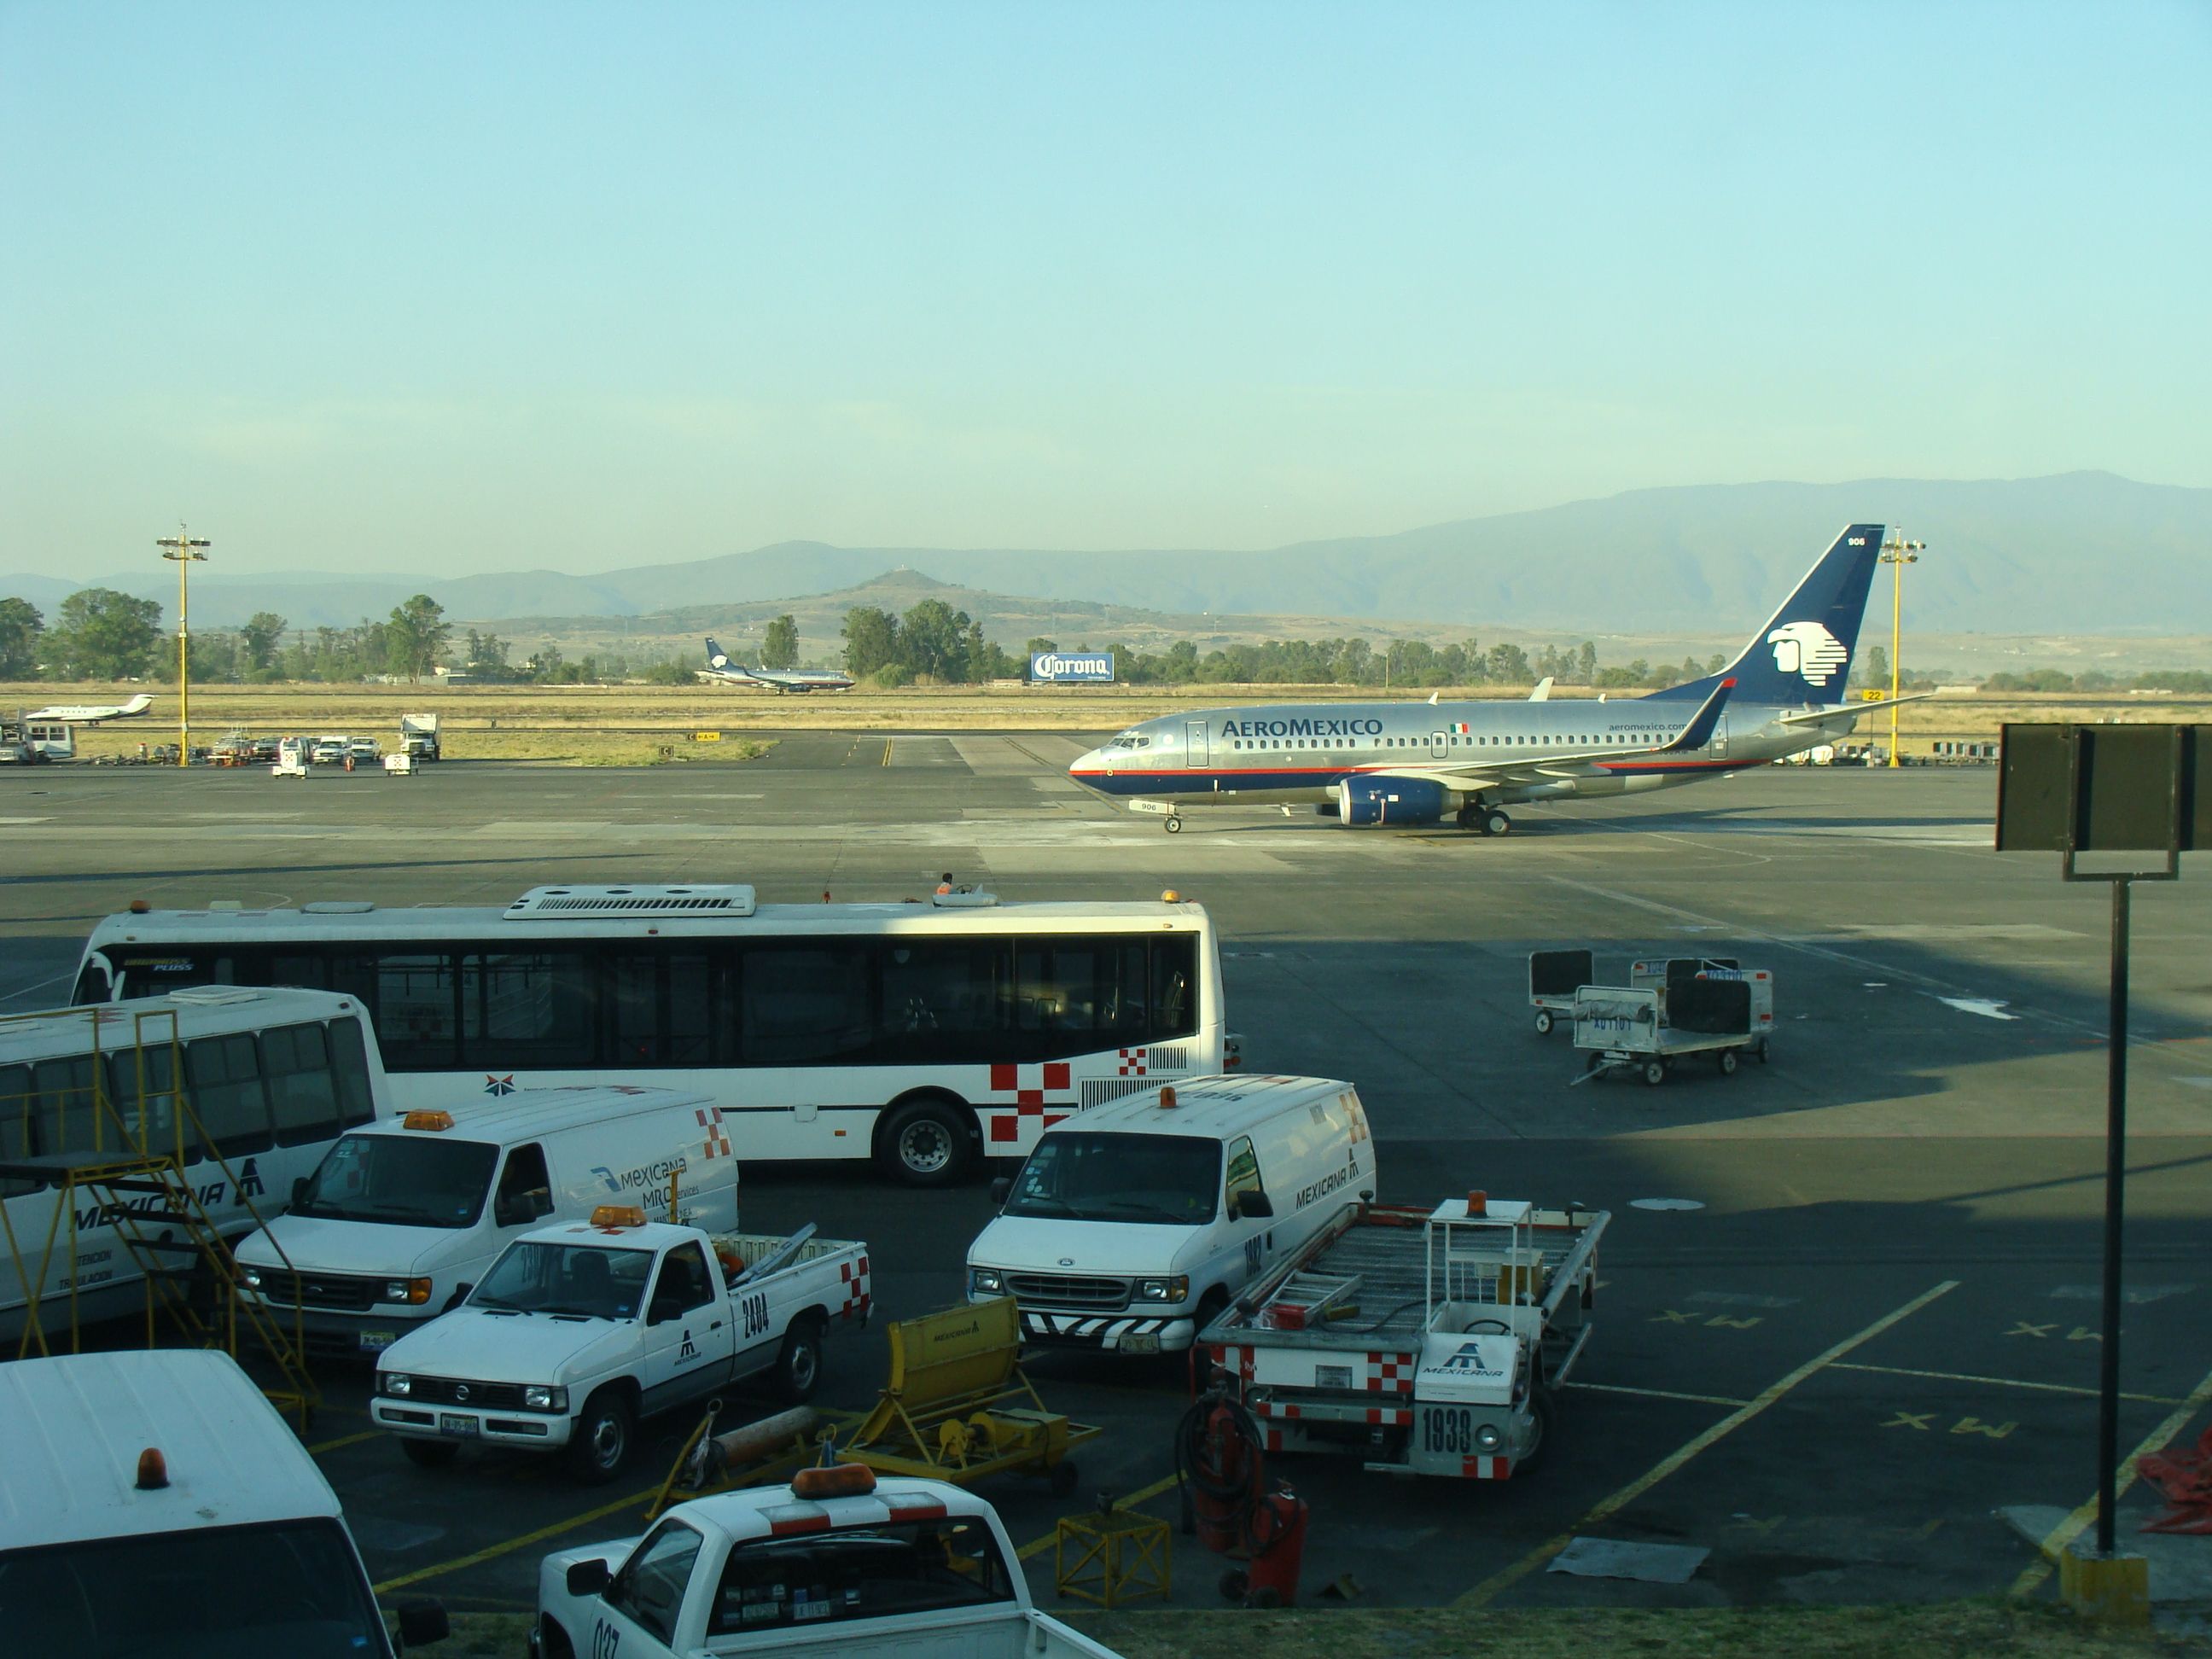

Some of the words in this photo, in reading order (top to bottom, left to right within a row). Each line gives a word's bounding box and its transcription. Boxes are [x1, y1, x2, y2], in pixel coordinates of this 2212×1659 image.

[1034, 655, 1108, 679] Corona
[1869, 691, 1881, 700] 22
[1609, 723, 1688, 731] aeromexico.com
[643, 1185, 672, 1209] MRO
[1296, 1168, 1347, 1209] MEXICANA
[742, 1293, 769, 1338] 2404
[1423, 1367, 1504, 1377] MEXICANA
